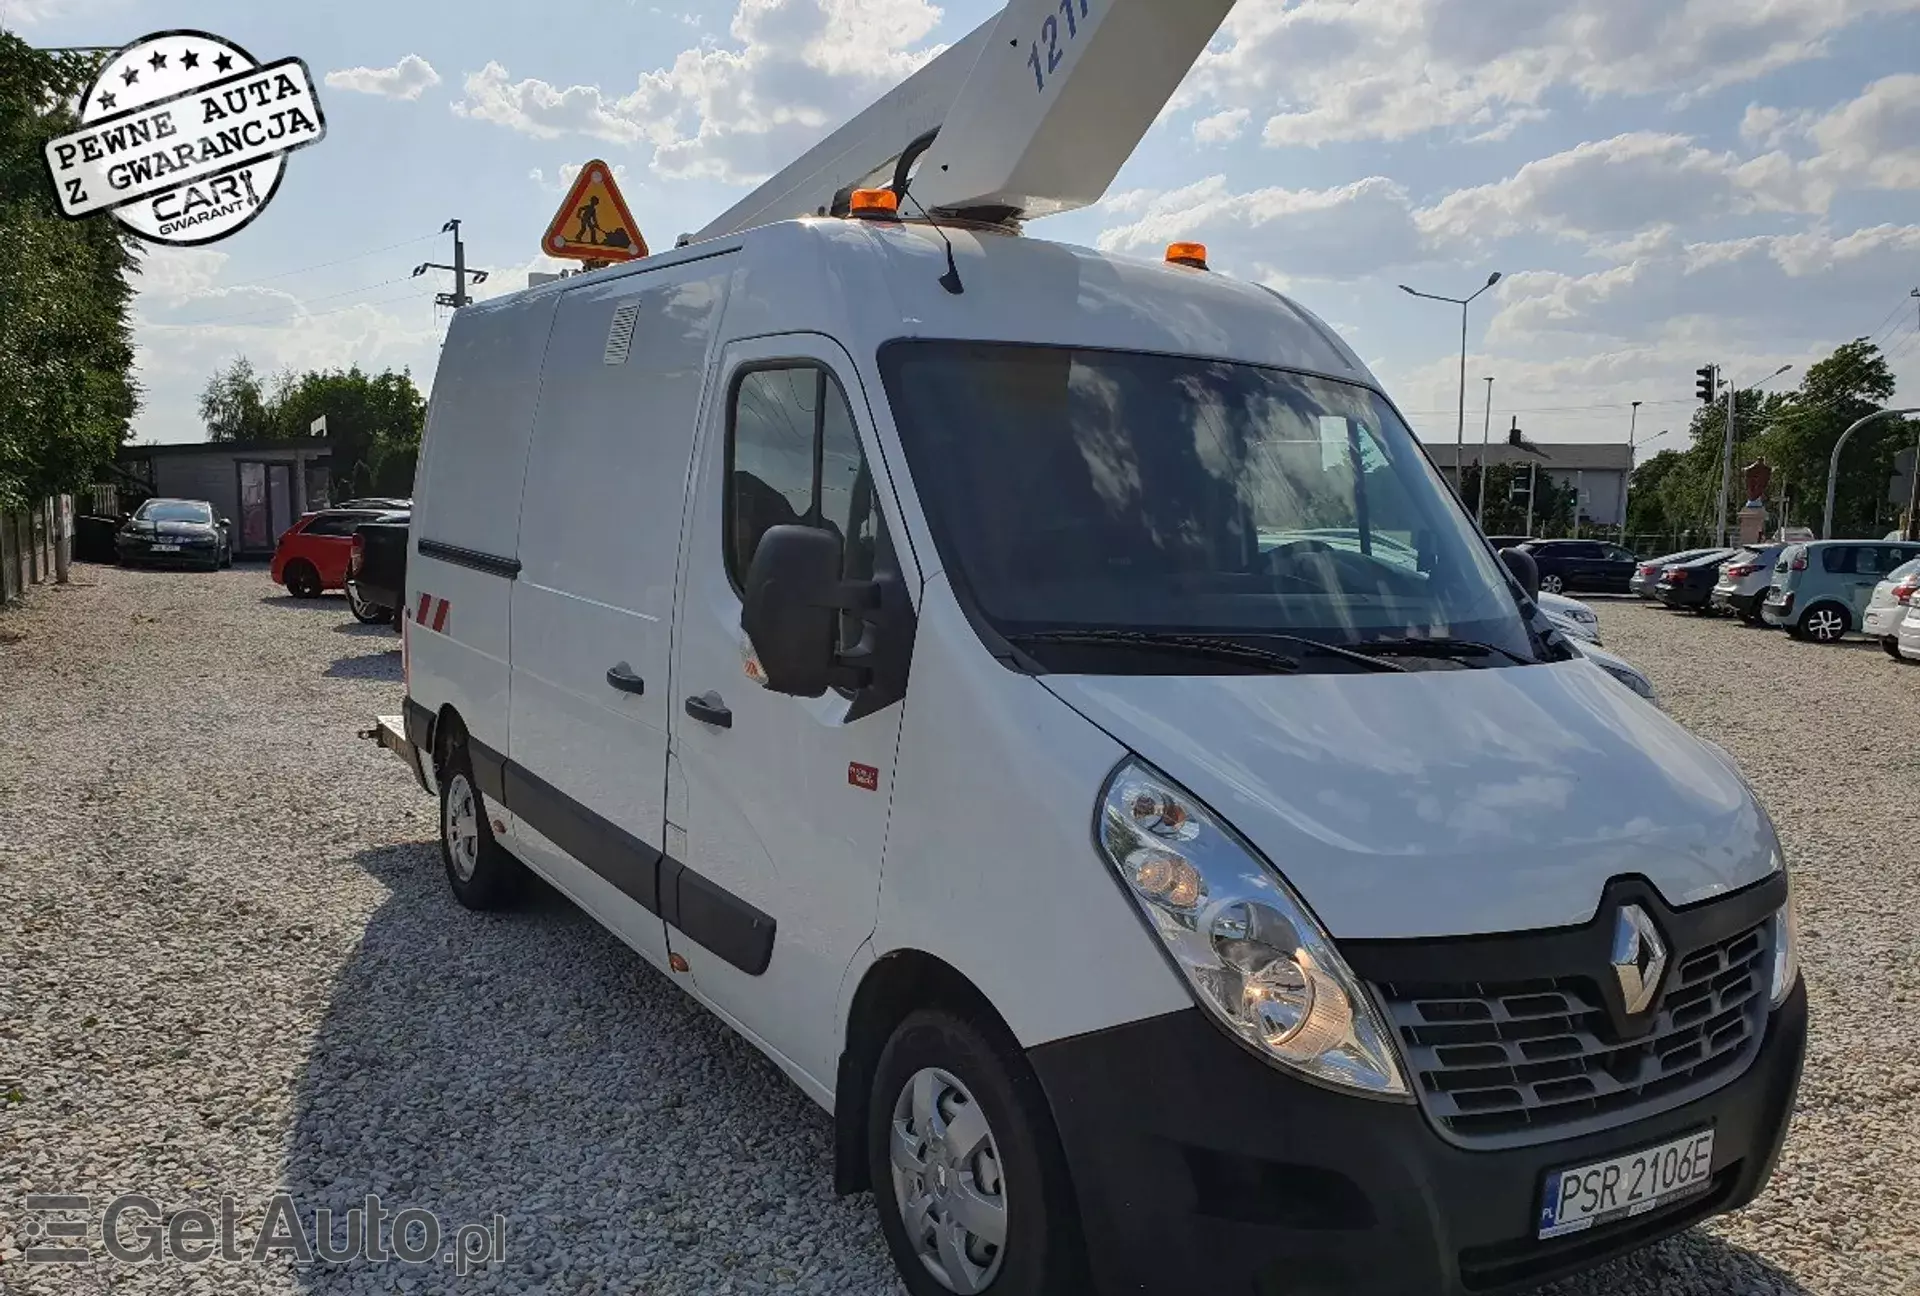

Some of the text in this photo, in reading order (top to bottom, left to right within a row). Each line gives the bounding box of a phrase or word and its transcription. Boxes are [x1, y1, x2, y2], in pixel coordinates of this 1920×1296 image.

[1558, 1165, 1621, 1220] PSR
[1628, 1136, 1710, 1201] 2106E
[1542, 1208, 1554, 1219] PL
